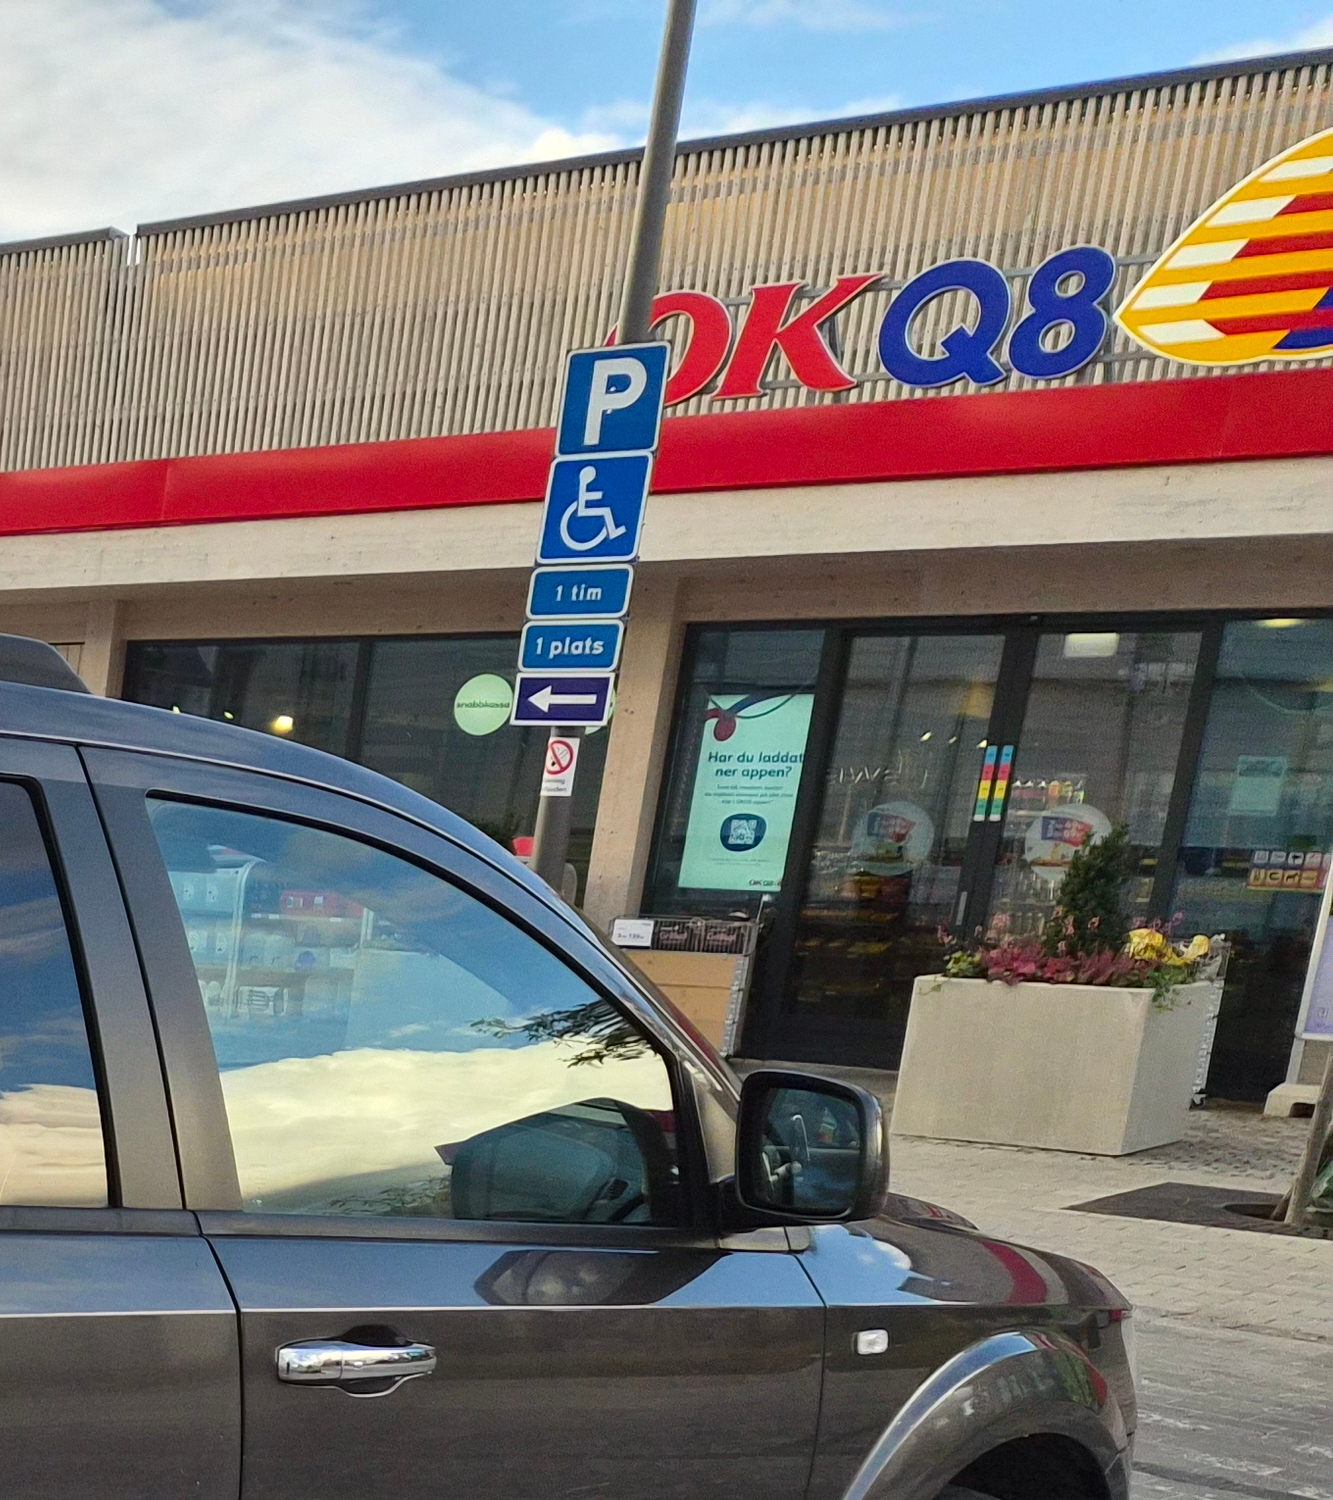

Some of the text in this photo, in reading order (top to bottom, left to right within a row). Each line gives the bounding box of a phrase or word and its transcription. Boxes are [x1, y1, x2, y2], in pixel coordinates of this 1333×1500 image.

[583, 357, 647, 446] P
[555, 584, 602, 601] 1 tim
[535, 637, 604, 659] 1 plats
[456, 699, 510, 709] snabbkassa
[707, 751, 733, 763] Har
[737, 752, 754, 763] du
[715, 766, 793, 780] ner appen?
